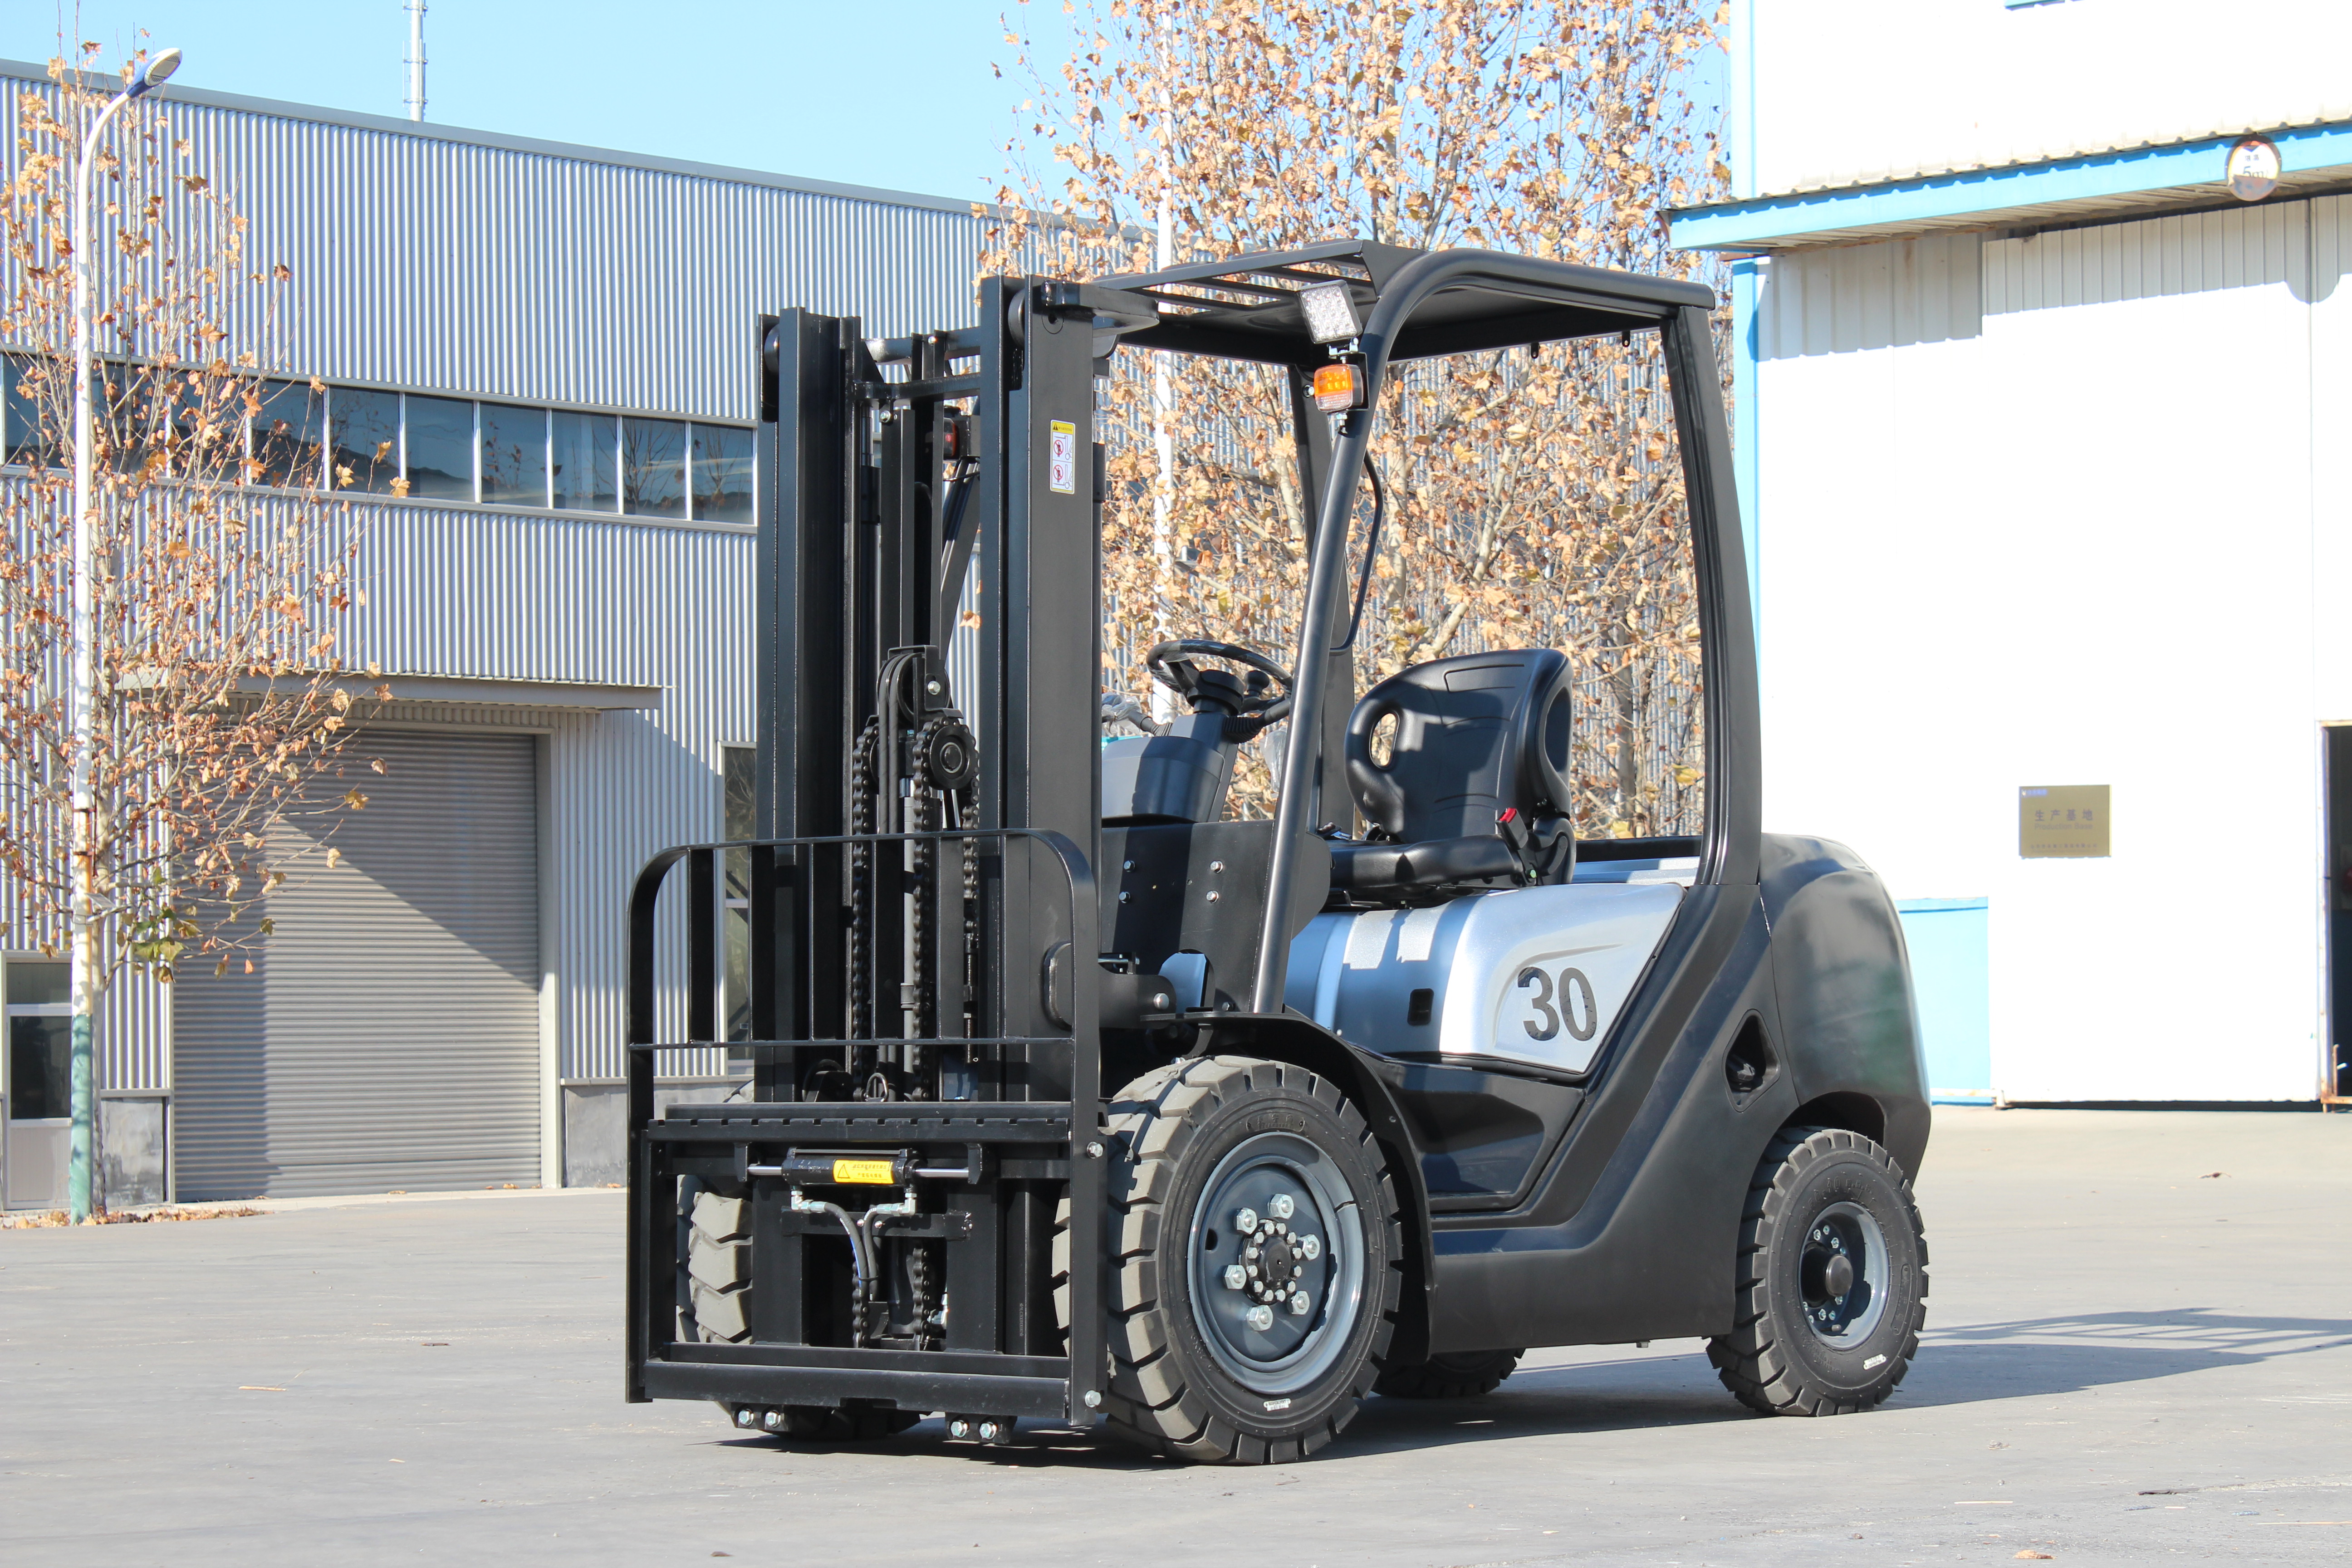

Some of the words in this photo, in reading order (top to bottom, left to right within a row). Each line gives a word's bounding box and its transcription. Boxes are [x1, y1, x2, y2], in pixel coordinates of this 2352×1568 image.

[2034, 808, 2093, 821] 生产基地
[1517, 966, 1597, 1041] 30
